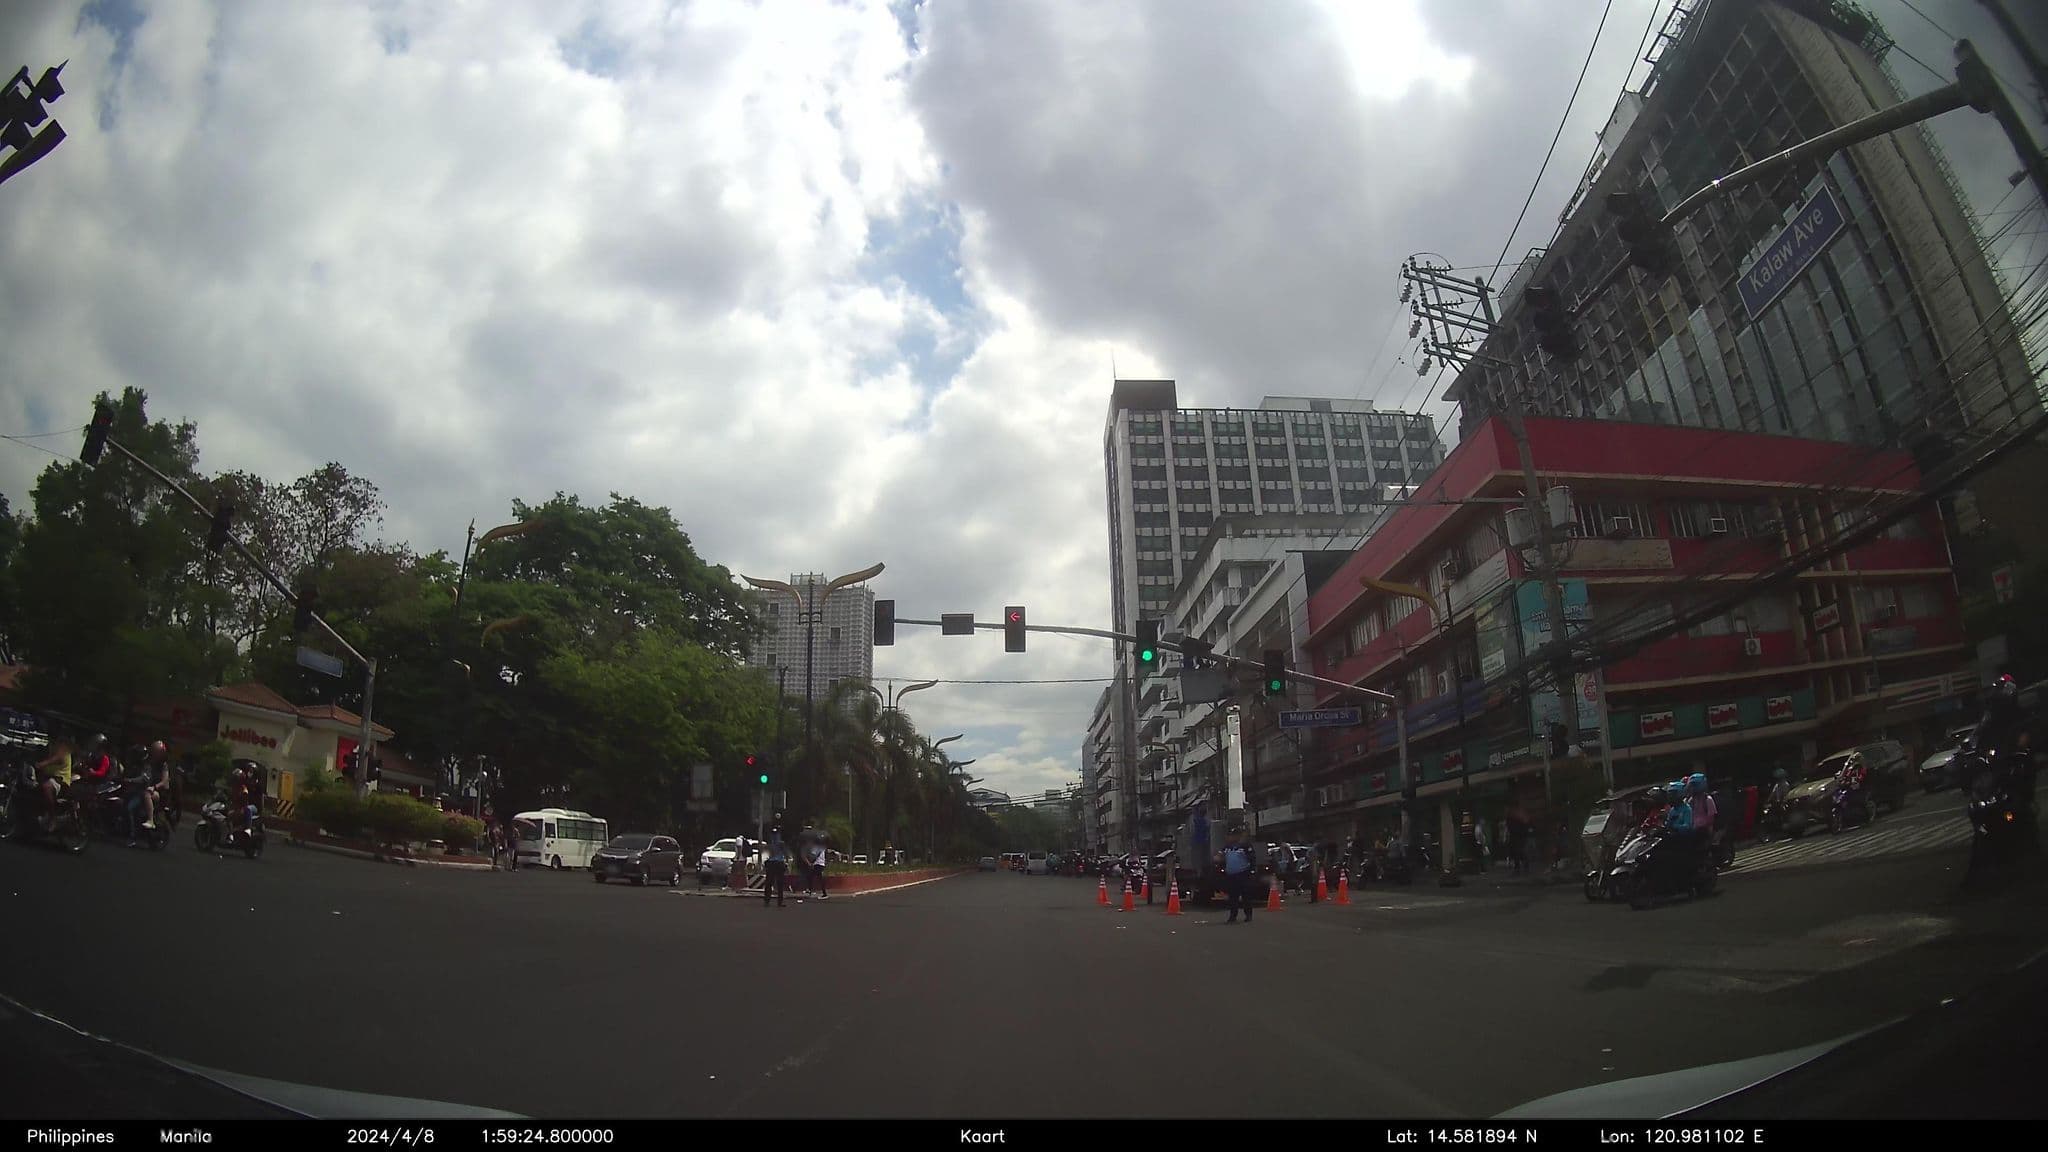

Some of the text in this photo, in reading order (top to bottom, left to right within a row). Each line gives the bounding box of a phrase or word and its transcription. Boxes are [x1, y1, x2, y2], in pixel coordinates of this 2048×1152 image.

[1749, 240, 1793, 293] Kalaw
[1793, 209, 1824, 248] Ave
[1290, 712, 1313, 721] Maria
[220, 725, 277, 749] Jollibee
